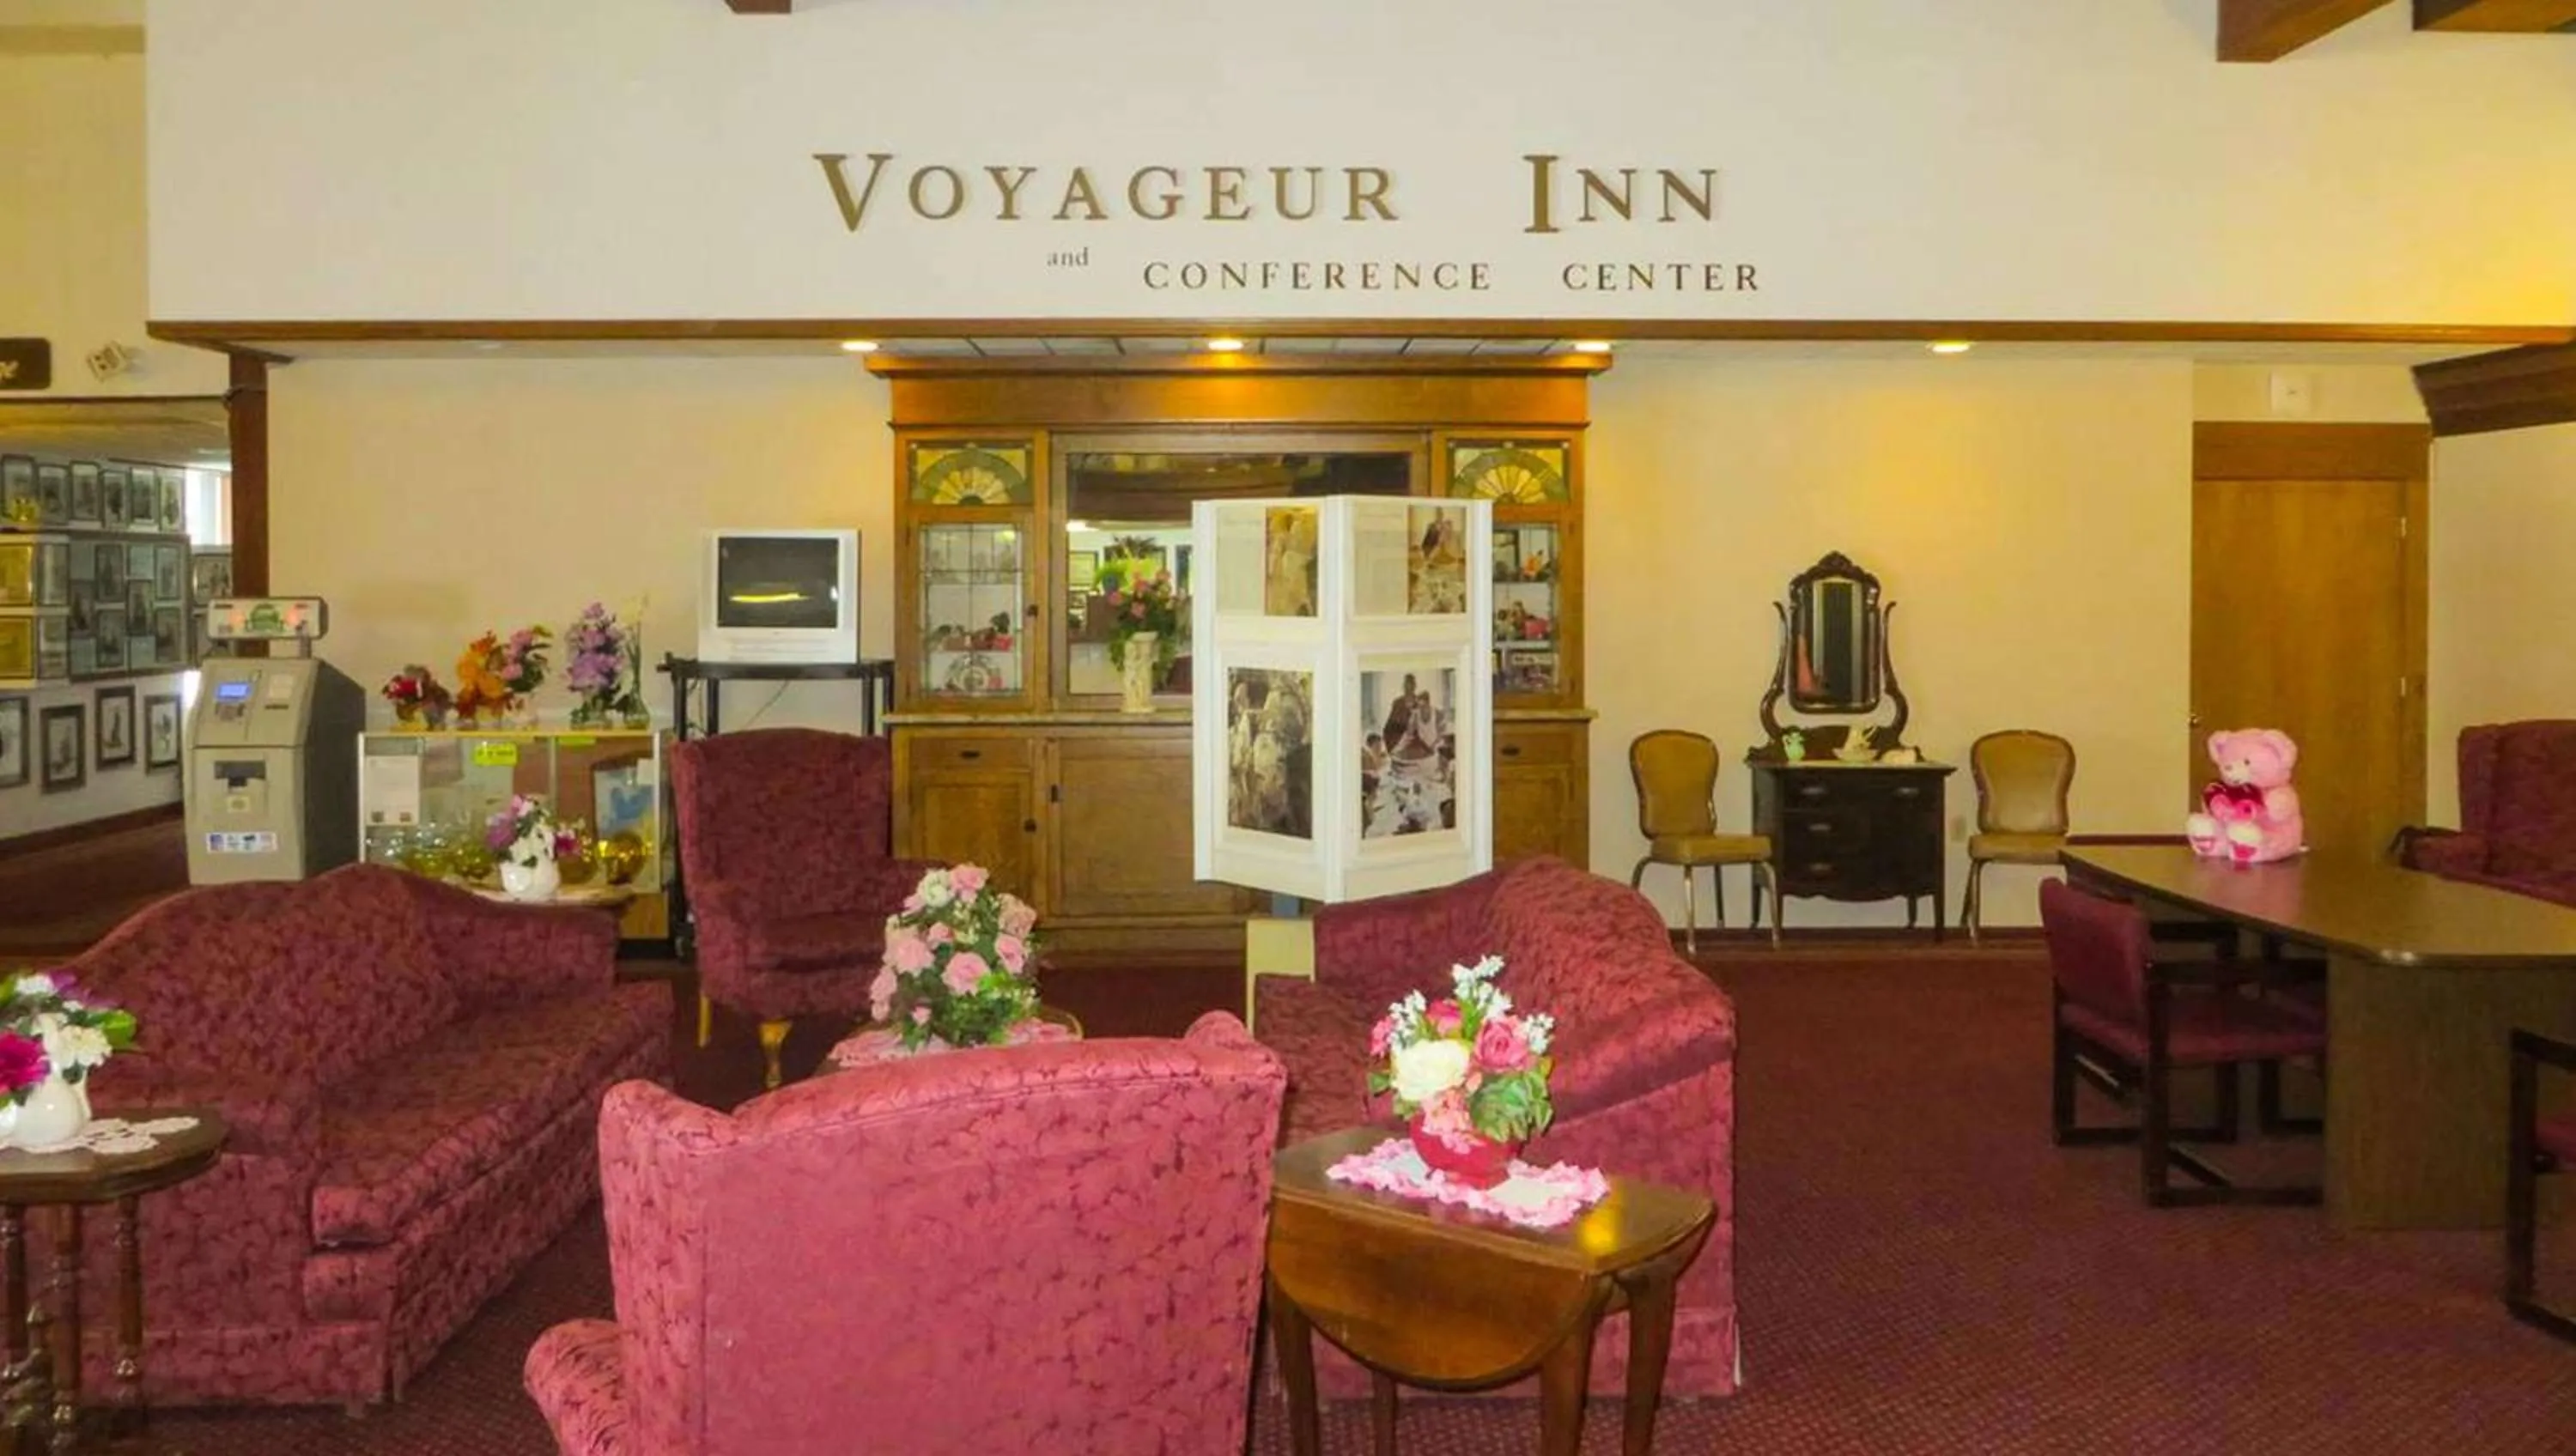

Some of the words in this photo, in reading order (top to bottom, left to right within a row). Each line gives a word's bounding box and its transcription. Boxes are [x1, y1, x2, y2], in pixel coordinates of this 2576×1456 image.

[812, 153, 1399, 233] VOYAGEUR
[1522, 155, 1717, 234] INN
[1047, 246, 1089, 267] and
[1143, 262, 1490, 291] CONFERENCE
[1562, 263, 1759, 292] CENTER
